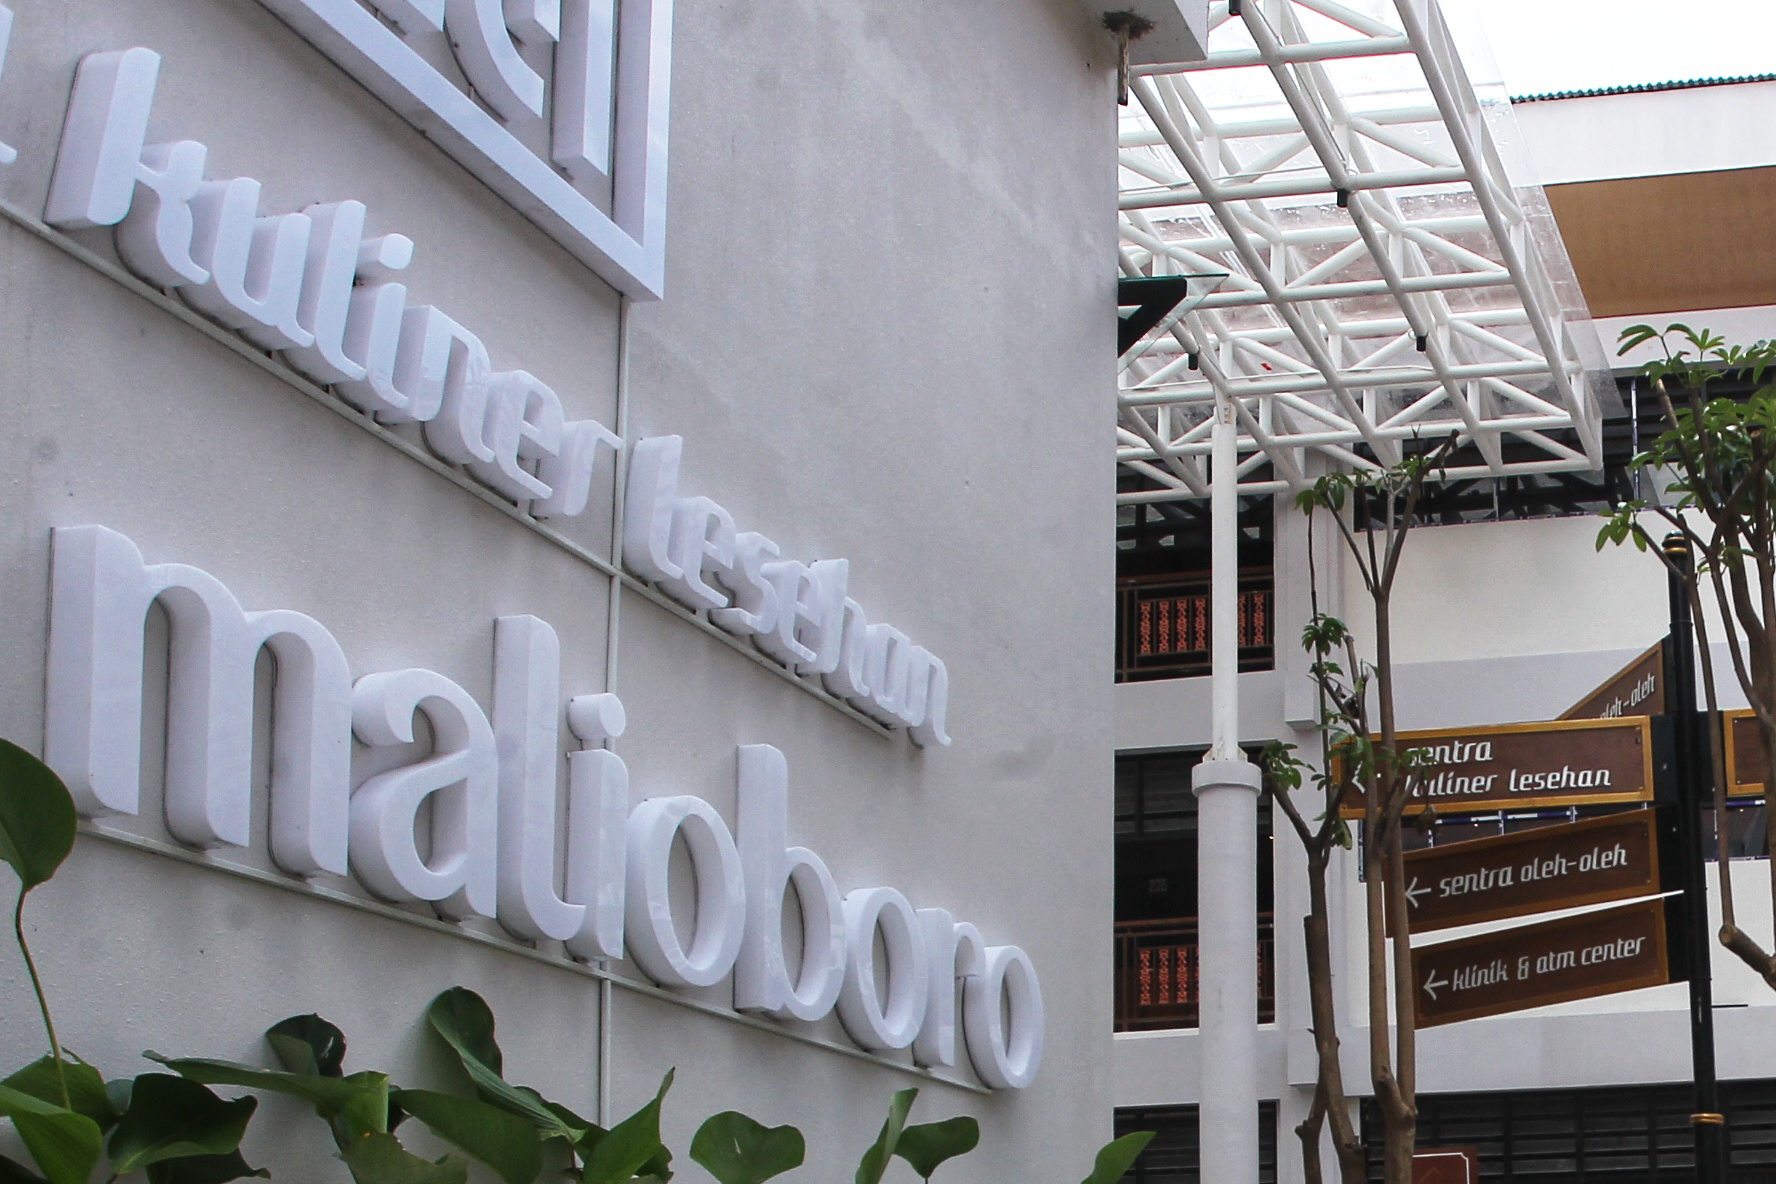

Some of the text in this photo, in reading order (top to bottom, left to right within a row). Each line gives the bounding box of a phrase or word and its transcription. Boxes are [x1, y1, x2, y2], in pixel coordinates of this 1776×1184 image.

[45, 47, 622, 518] kuliner
[622, 434, 951, 748] lesehan
[1509, 765, 1612, 792] lesehan
[45, 524, 1044, 1091] malioboro
[1439, 843, 1628, 897] sentra oleh-oleh
[1453, 936, 1646, 992] klinik & atm center
